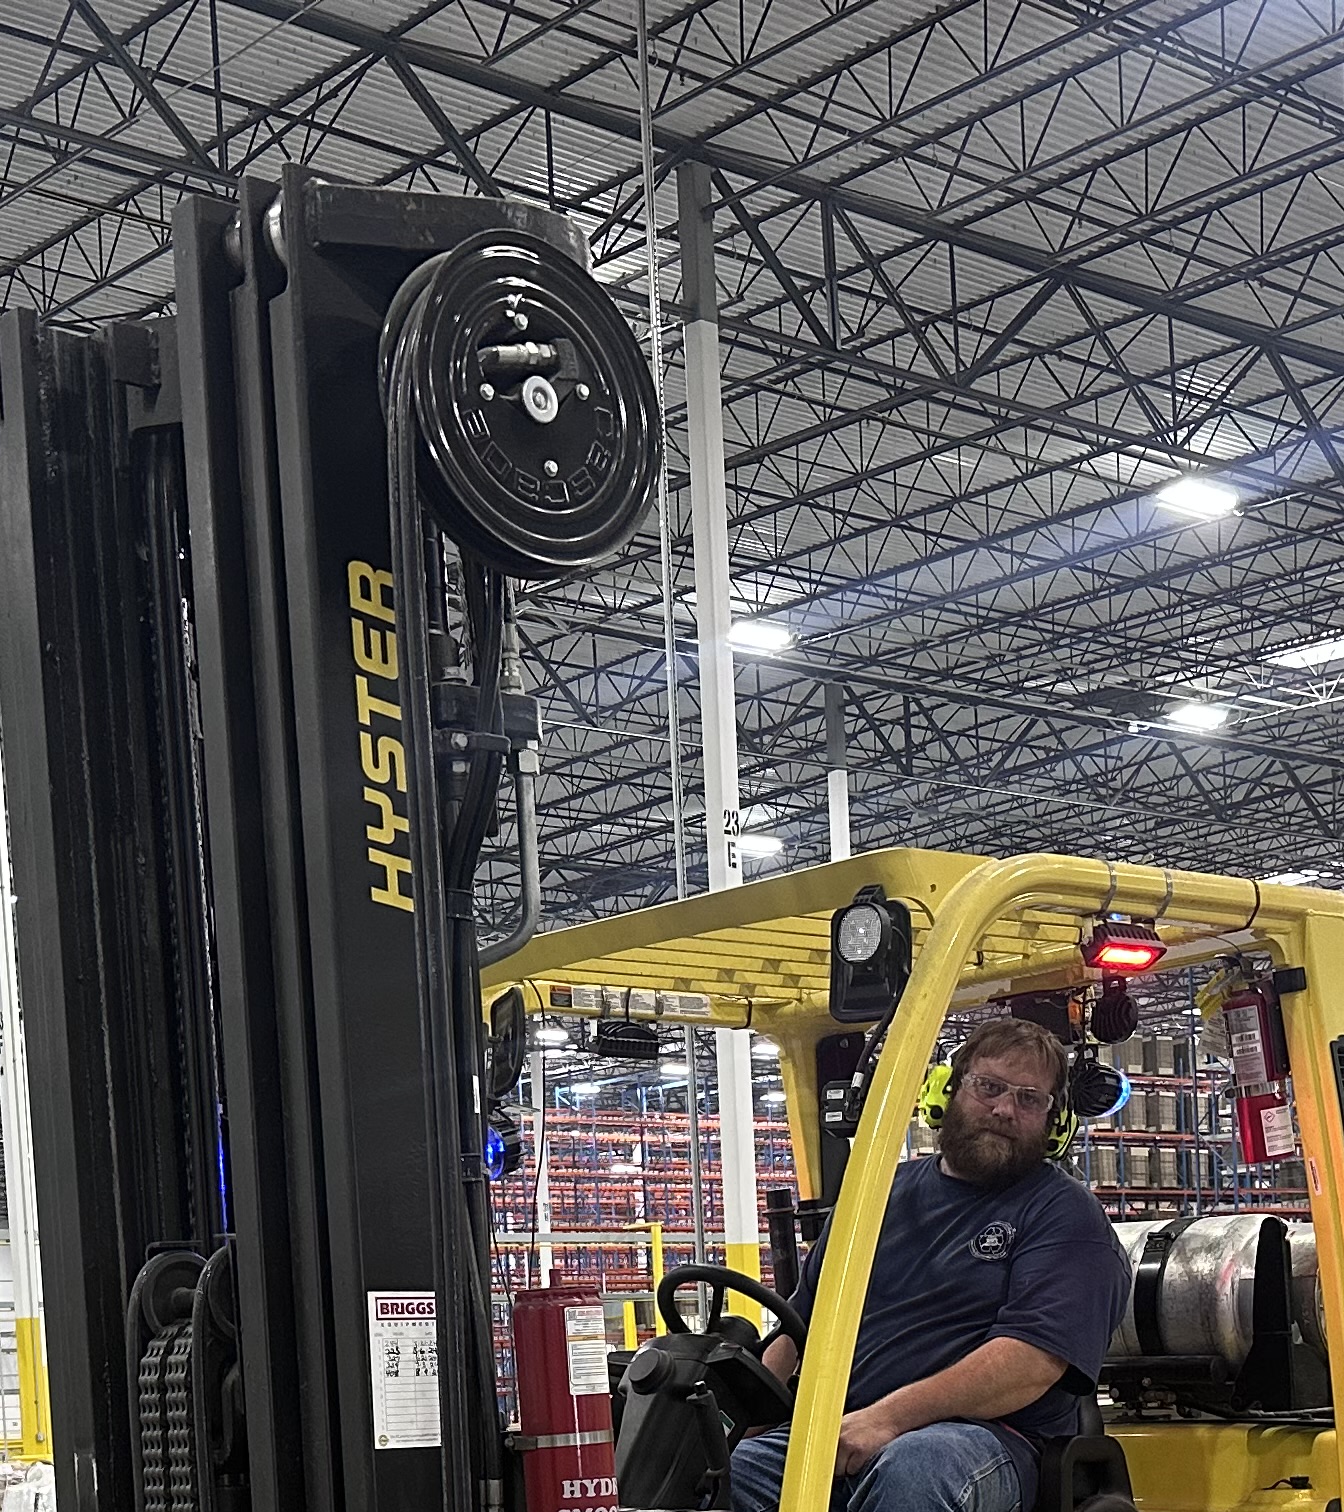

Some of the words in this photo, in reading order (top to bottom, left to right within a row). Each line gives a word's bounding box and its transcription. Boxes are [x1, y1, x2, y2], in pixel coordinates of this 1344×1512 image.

[348, 560, 415, 912] HYSTER
[723, 809, 739, 836] 23
[380, 1302, 435, 1315] BRIGGS
